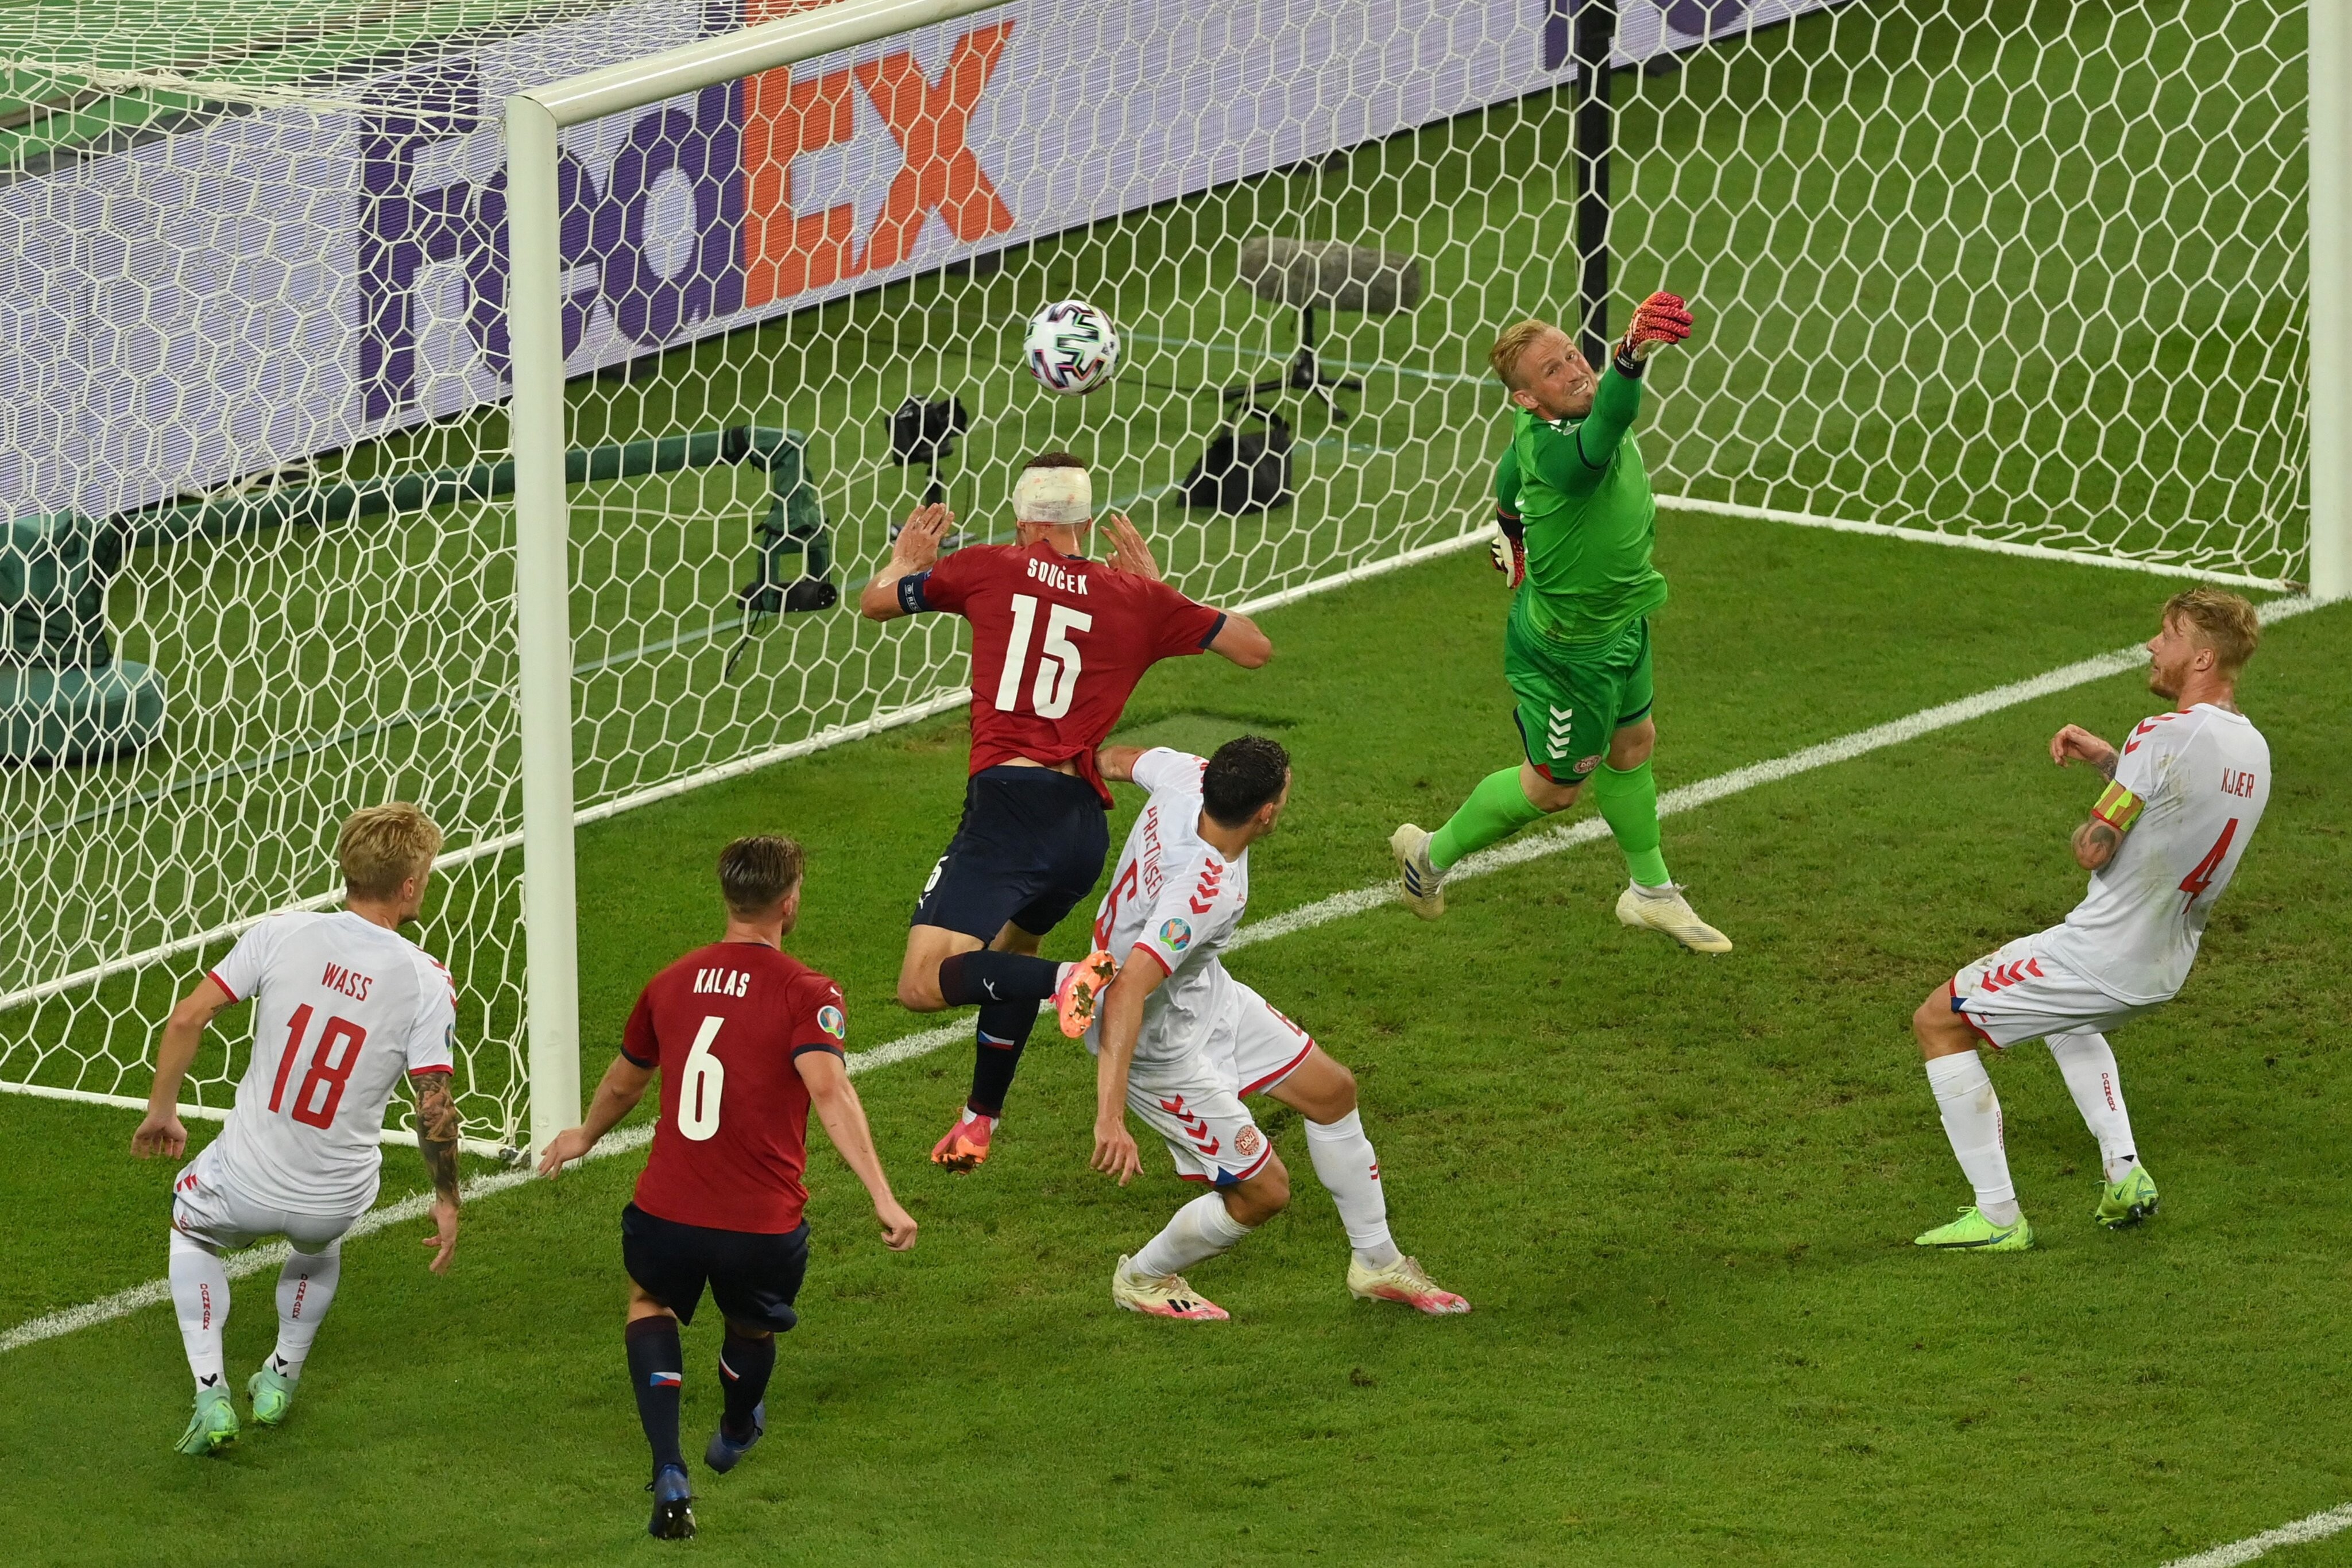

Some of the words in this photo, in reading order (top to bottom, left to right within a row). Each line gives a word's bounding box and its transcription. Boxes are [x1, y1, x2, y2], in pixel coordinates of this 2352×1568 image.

[995, 594, 1092, 719] 15
[2221, 767, 2254, 799] KJÆR
[2178, 818, 2238, 914] 4
[321, 962, 373, 1001] WASS
[693, 968, 750, 997] KALAS
[269, 1004, 366, 1129] 18
[678, 1016, 724, 1141] 6
[200, 1283, 211, 1330] DANMARK
[292, 1273, 308, 1319] DANMARK
